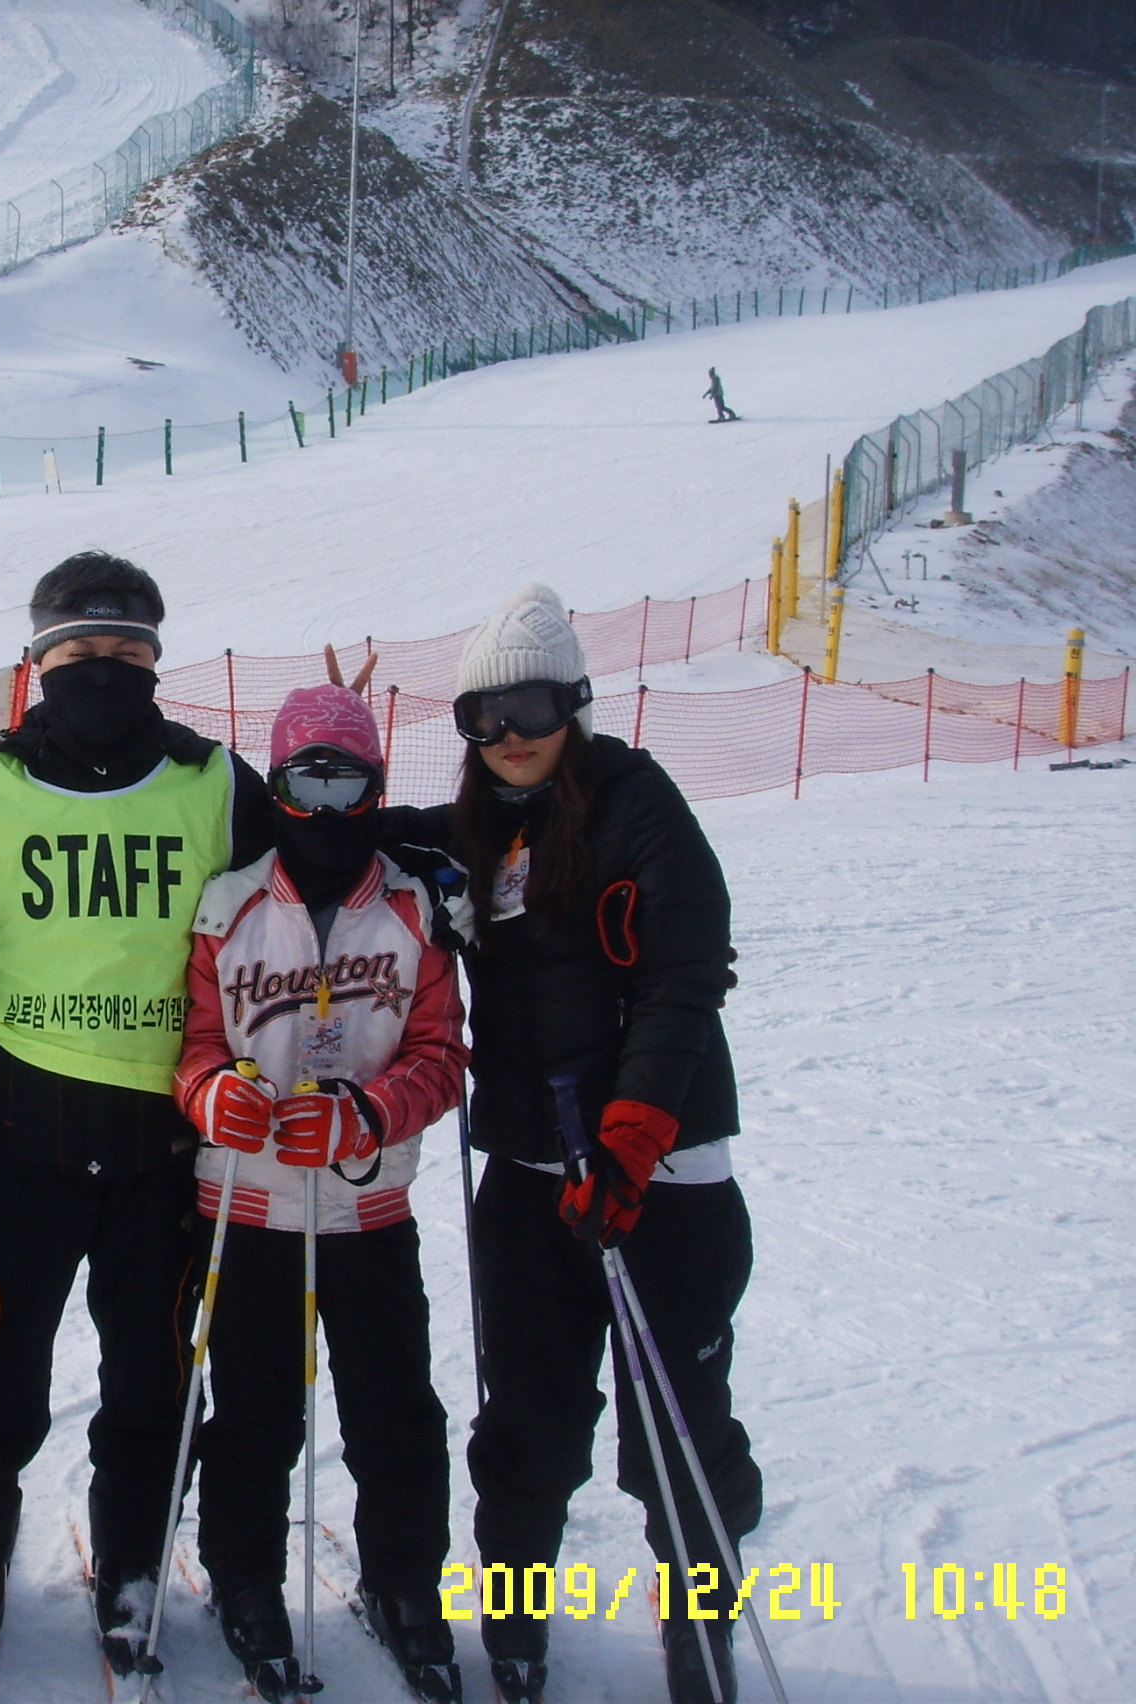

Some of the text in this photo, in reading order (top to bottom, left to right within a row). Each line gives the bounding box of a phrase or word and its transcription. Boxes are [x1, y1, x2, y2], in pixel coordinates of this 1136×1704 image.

[22, 834, 183, 920] STAFF
[4, 993, 186, 1032] 실로암 시각장애인 스키캠
